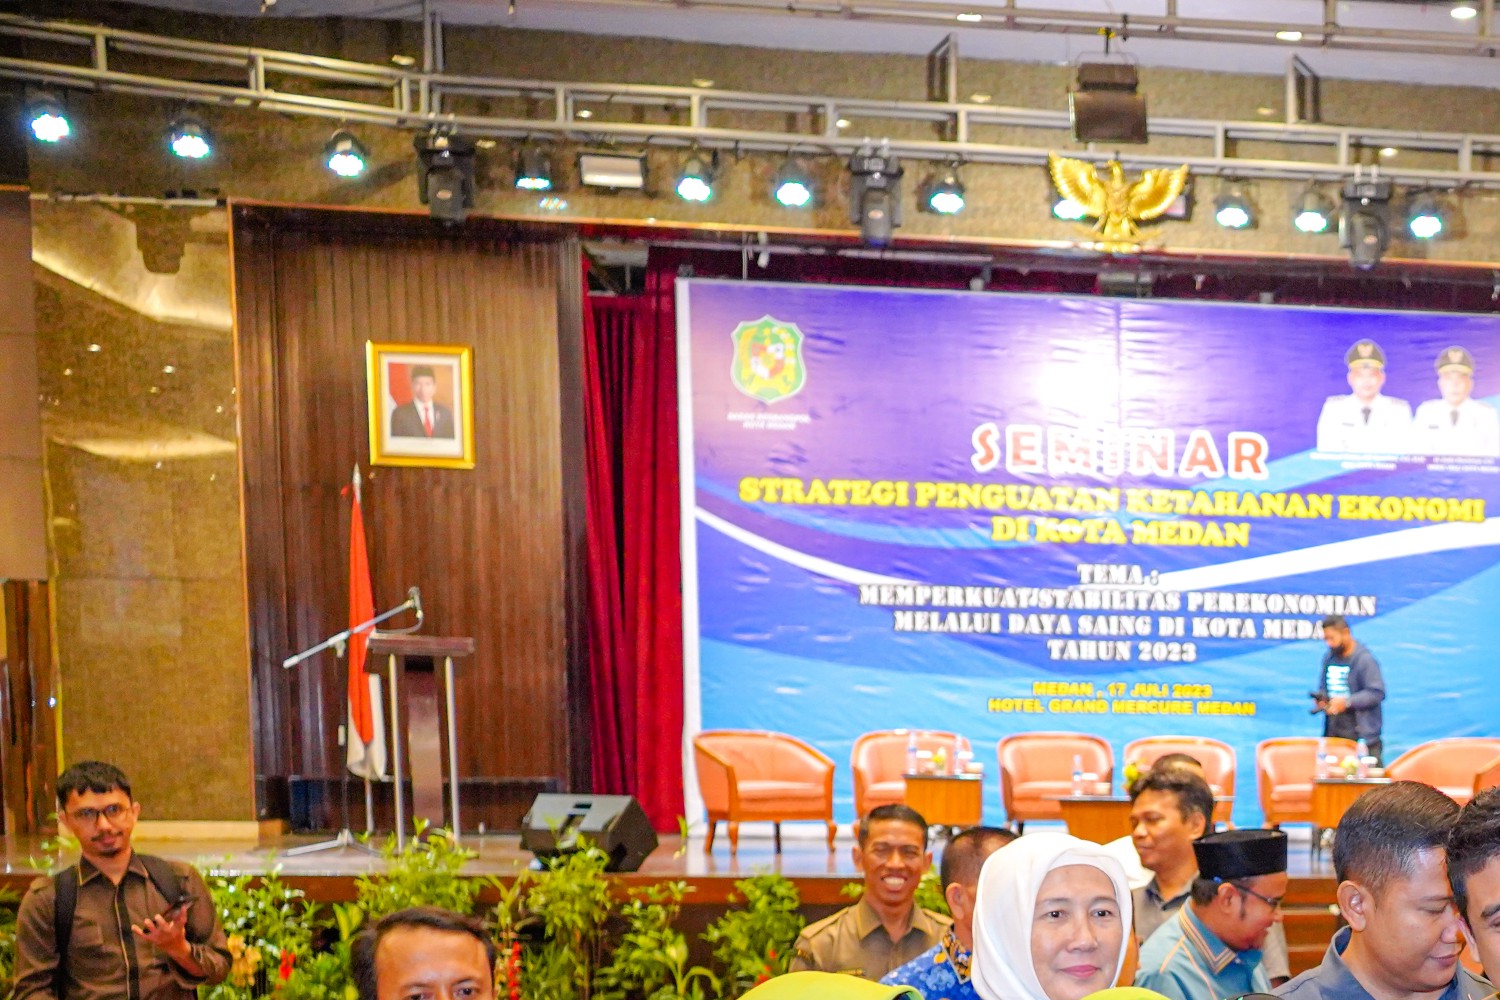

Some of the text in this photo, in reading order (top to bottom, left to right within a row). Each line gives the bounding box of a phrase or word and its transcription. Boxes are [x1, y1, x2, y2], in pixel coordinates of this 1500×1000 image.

[971, 422, 1269, 480] SEMINAR
[738, 477, 1486, 523] STRATEGI PENGUATAN KETAHANAN EKONOMI
[991, 516, 1250, 547] DI KOTA MEDAN
[1076, 563, 1145, 585] TEMA
[1187, 591, 1377, 616] PEREKONOMIAN
[894, 610, 1324, 641] MELALUI DAYA SAING DI KOTA MEDA
[1047, 638, 1197, 662] TAHUN 2023
[1033, 682, 1093, 696] MEDAN
[1107, 682, 1126, 697] 17
[1130, 683, 1169, 697] JULI
[1172, 684, 1213, 698] 2023
[988, 698, 1256, 716] HOTEL GRAND MERCURE MEDAN
